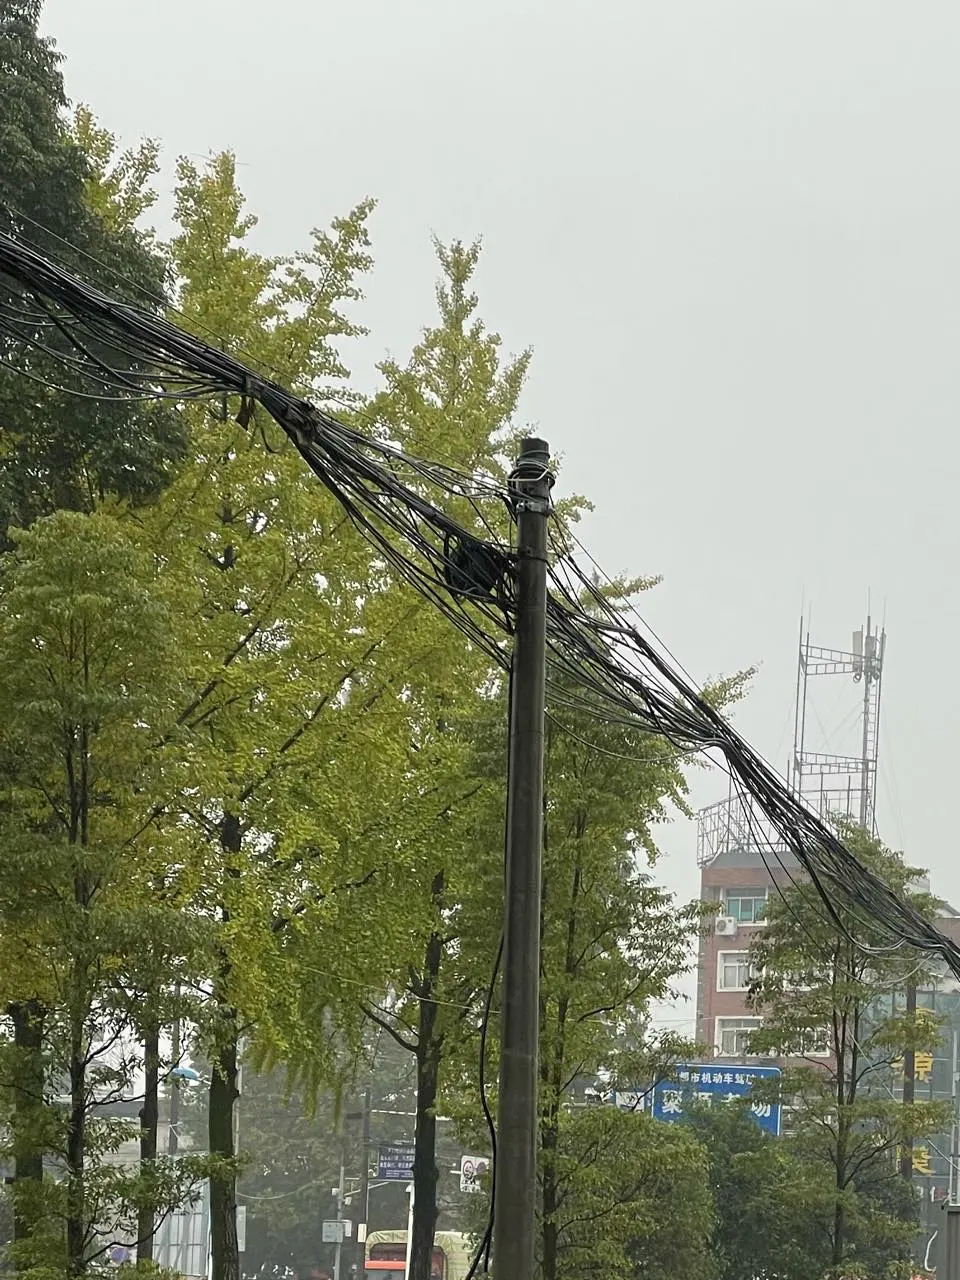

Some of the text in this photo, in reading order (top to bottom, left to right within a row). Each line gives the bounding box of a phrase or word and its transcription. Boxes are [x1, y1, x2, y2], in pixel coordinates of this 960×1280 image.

[673, 1071, 765, 1085] 都市机动车驾
